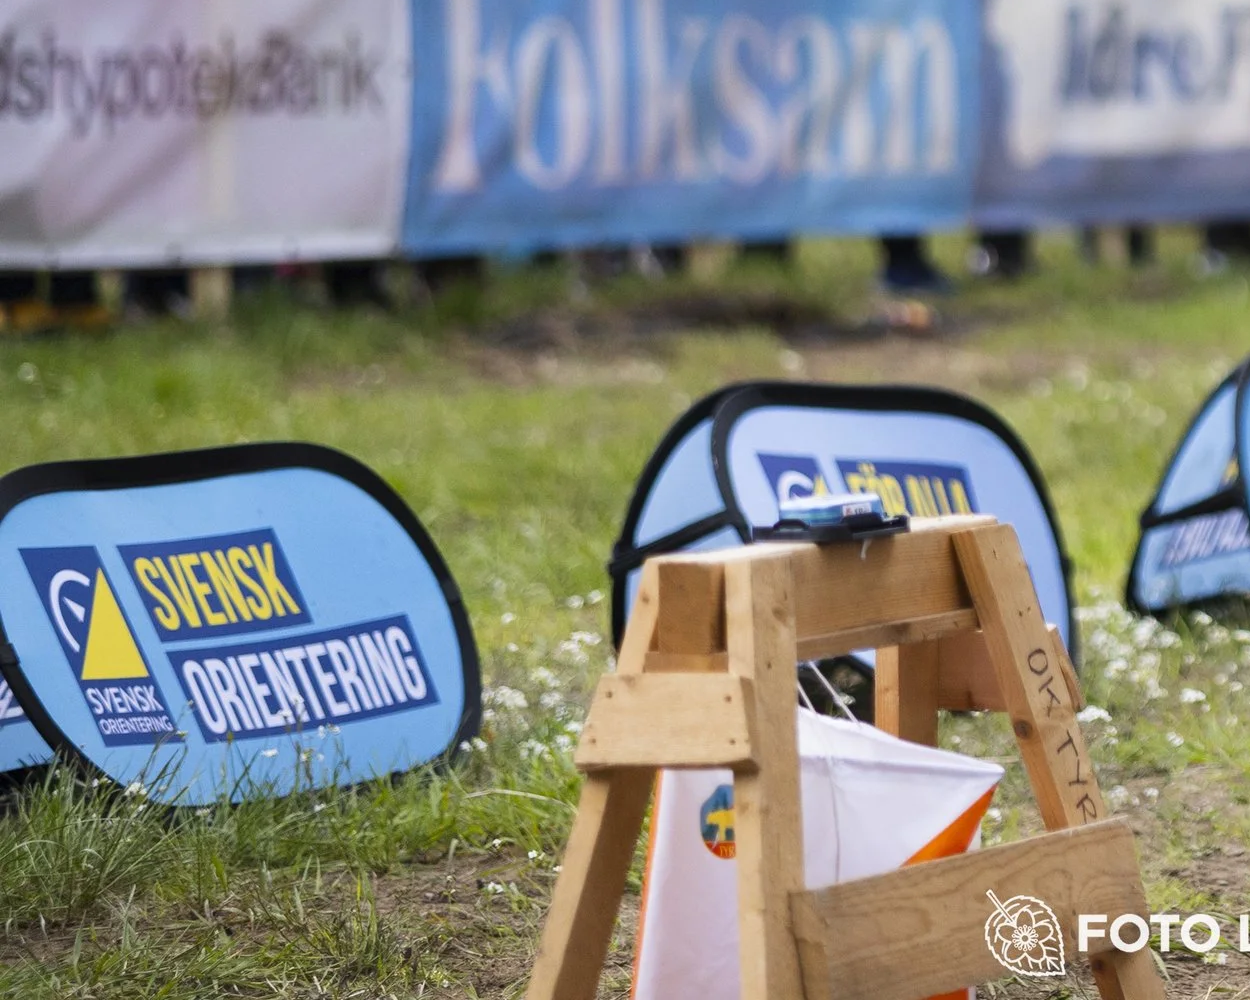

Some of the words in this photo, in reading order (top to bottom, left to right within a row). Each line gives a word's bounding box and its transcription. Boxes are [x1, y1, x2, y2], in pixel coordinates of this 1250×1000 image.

[133, 542, 301, 631] SVENSK
[87, 685, 165, 714] SVENSK
[181, 626, 428, 735] ORIENTERING
[1027, 648, 1061, 718] OK
[99, 714, 174, 735] ORIENTERING
